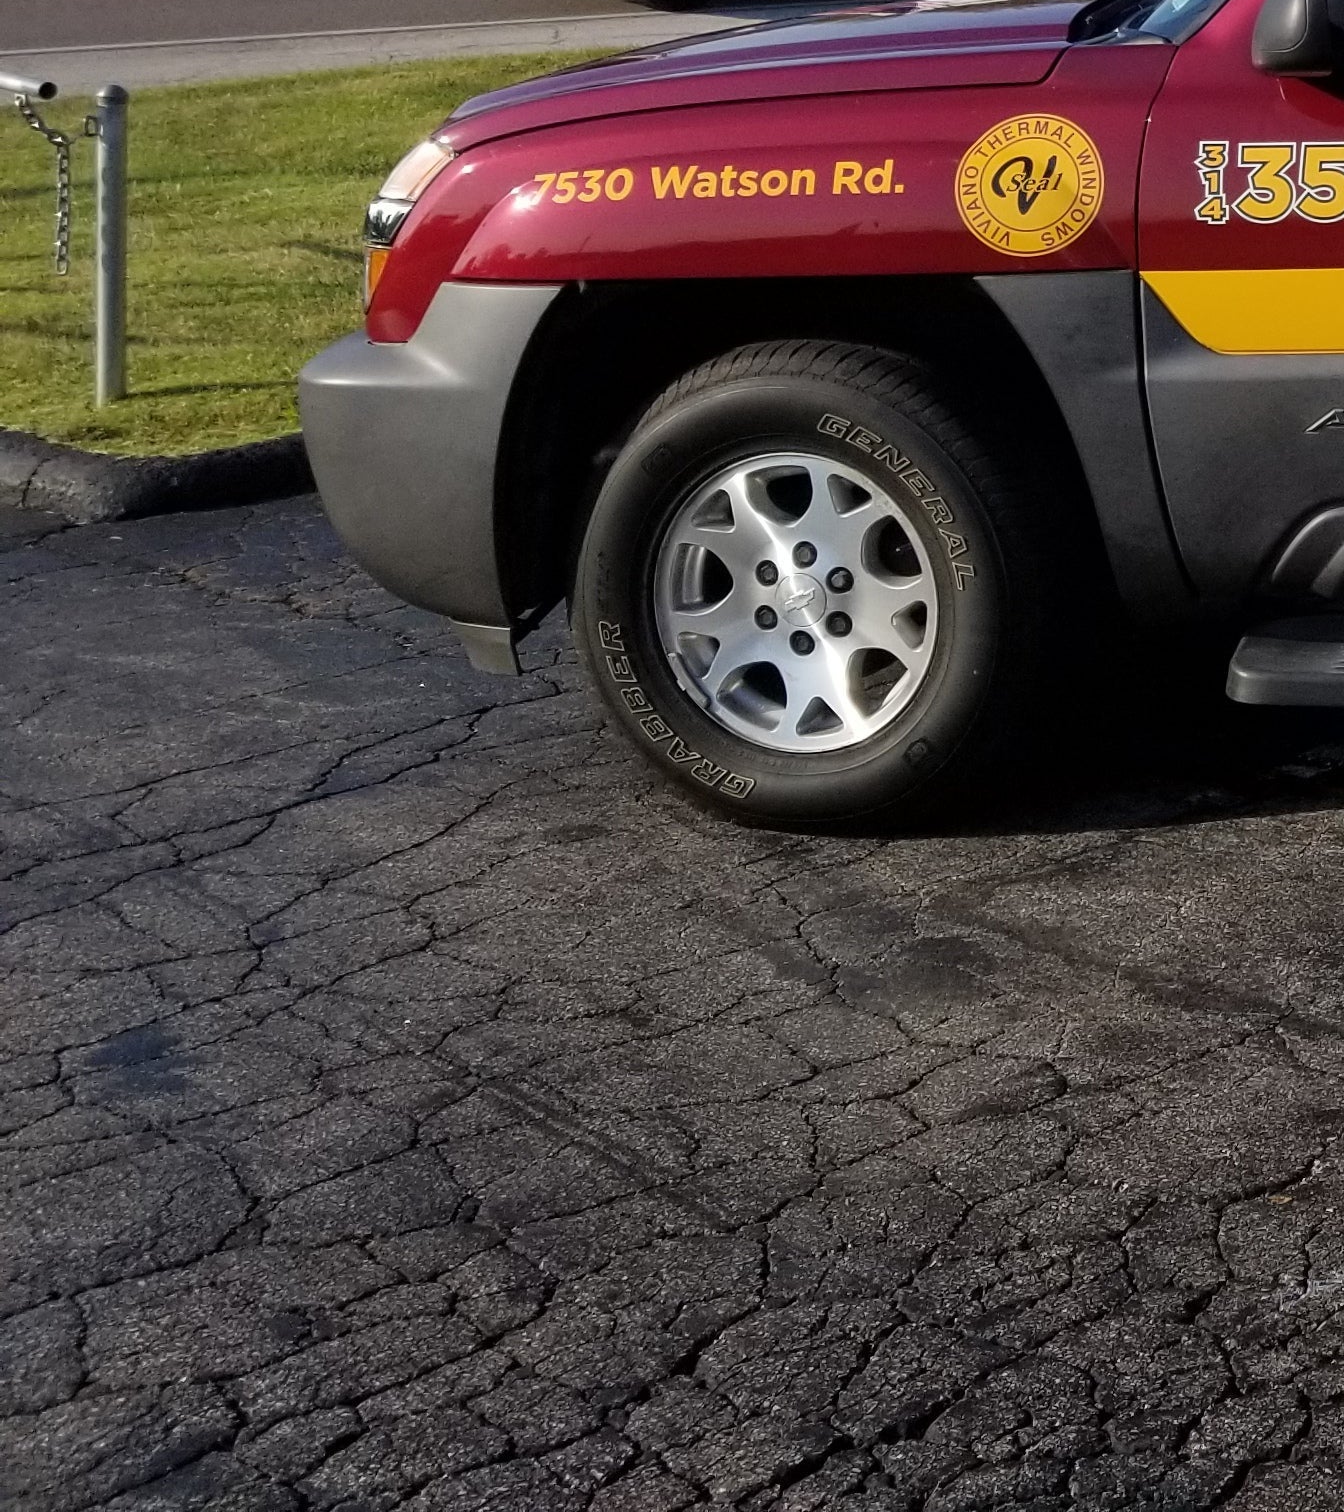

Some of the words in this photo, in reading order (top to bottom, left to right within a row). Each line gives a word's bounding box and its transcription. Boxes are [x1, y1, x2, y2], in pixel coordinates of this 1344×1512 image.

[974, 120, 1075, 159] THERMAL
[532, 168, 634, 205] 7530
[650, 164, 816, 200] Watson
[832, 159, 906, 195] Rd.
[962, 165, 1012, 248] VIVIANO
[1005, 172, 1064, 193] Seal
[1040, 148, 1098, 247] WINDOWS
[816, 412, 978, 592] GENERAL
[597, 619, 757, 800] GRABBER
